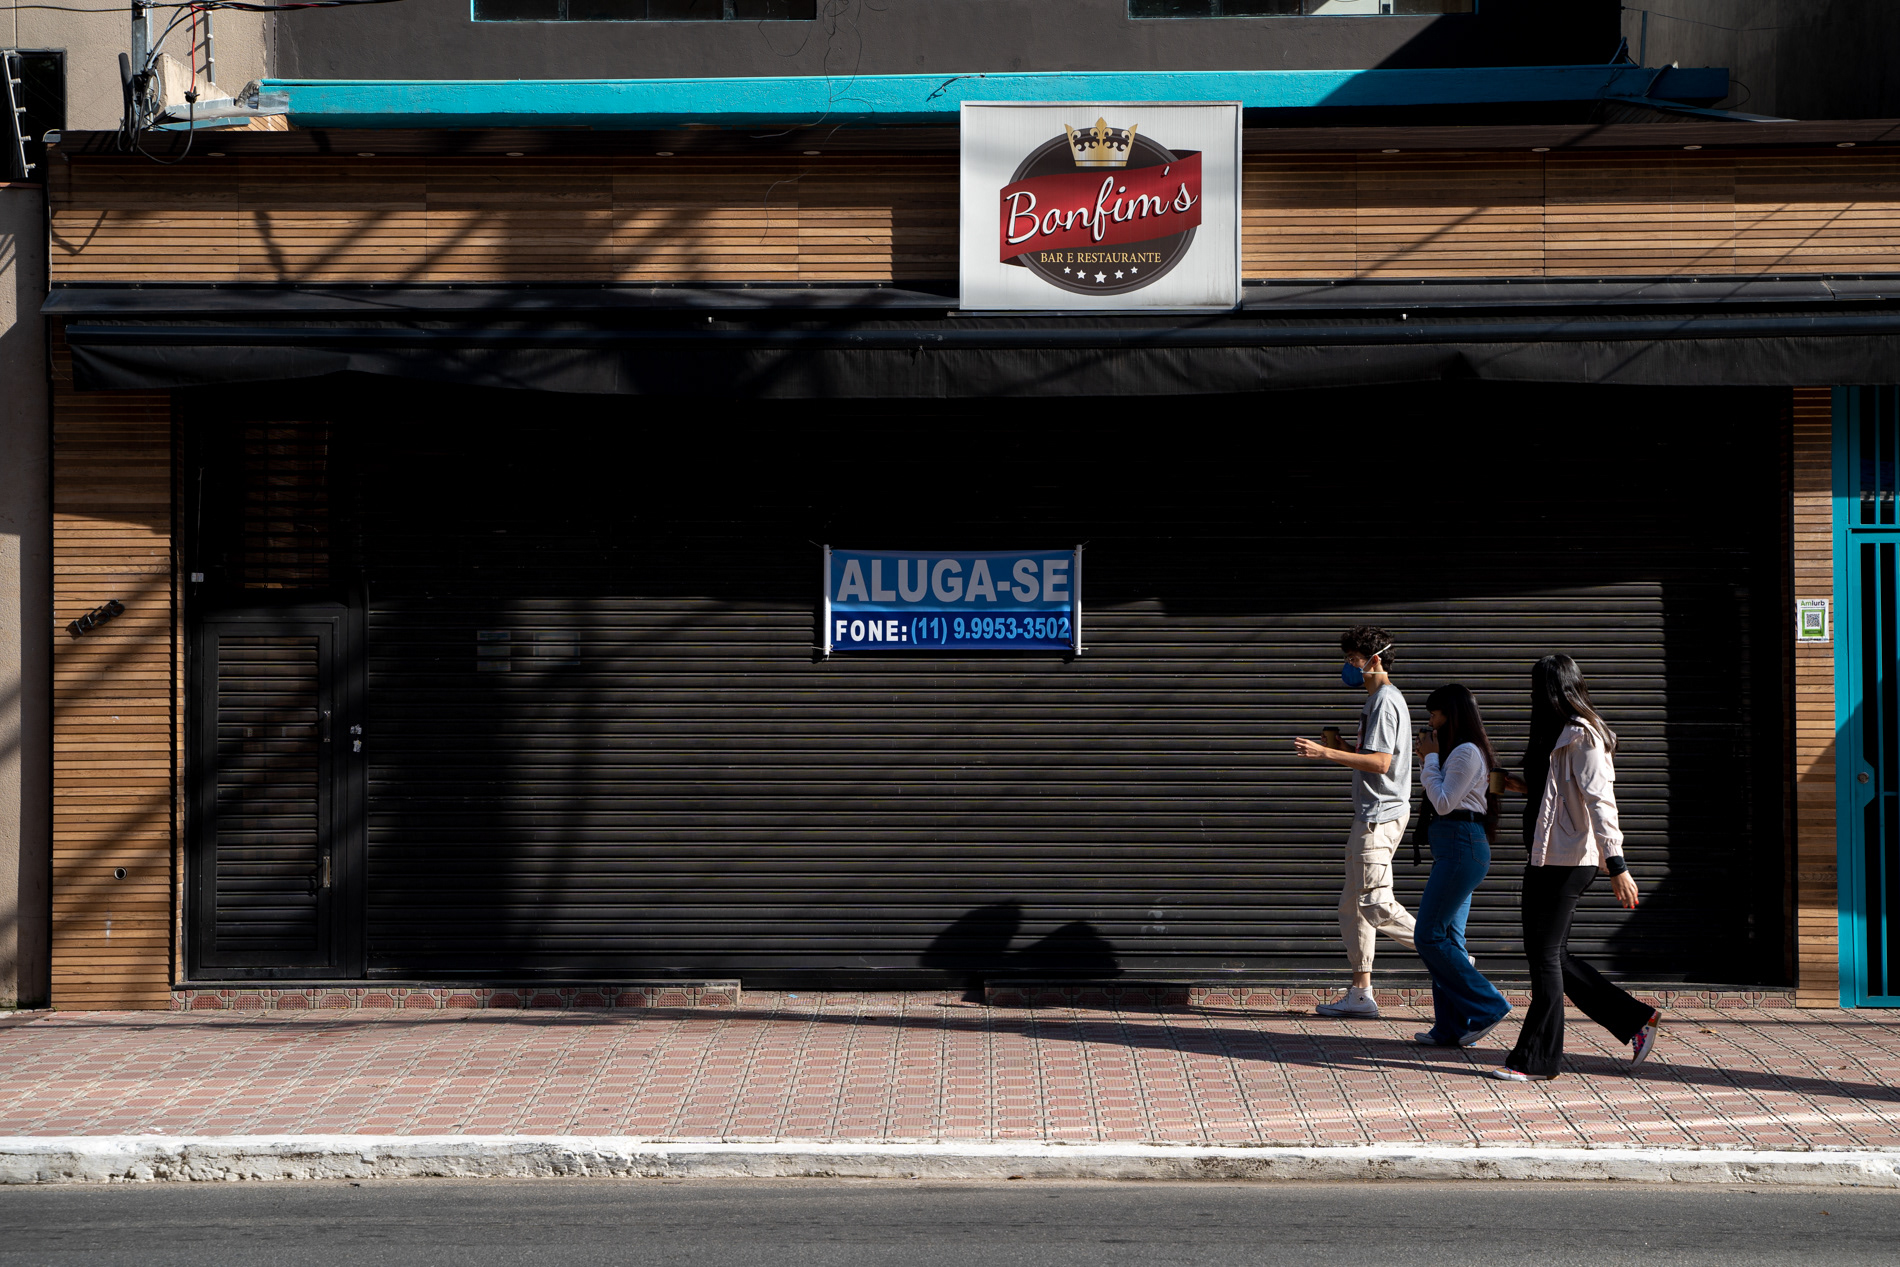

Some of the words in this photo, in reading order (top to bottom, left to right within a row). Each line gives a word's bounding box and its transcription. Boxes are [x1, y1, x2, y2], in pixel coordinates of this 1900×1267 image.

[1005, 166, 1198, 244] Bonfim's
[1040, 252, 1065, 263] BAR
[1067, 252, 1074, 263] E
[1077, 252, 1162, 263] RESTAURANTE
[836, 559, 1069, 602] ALUGA-SE
[835, 619, 908, 642] FONE:
[911, 617, 948, 645] (11)
[953, 617, 1070, 640] 9.9953-3502
